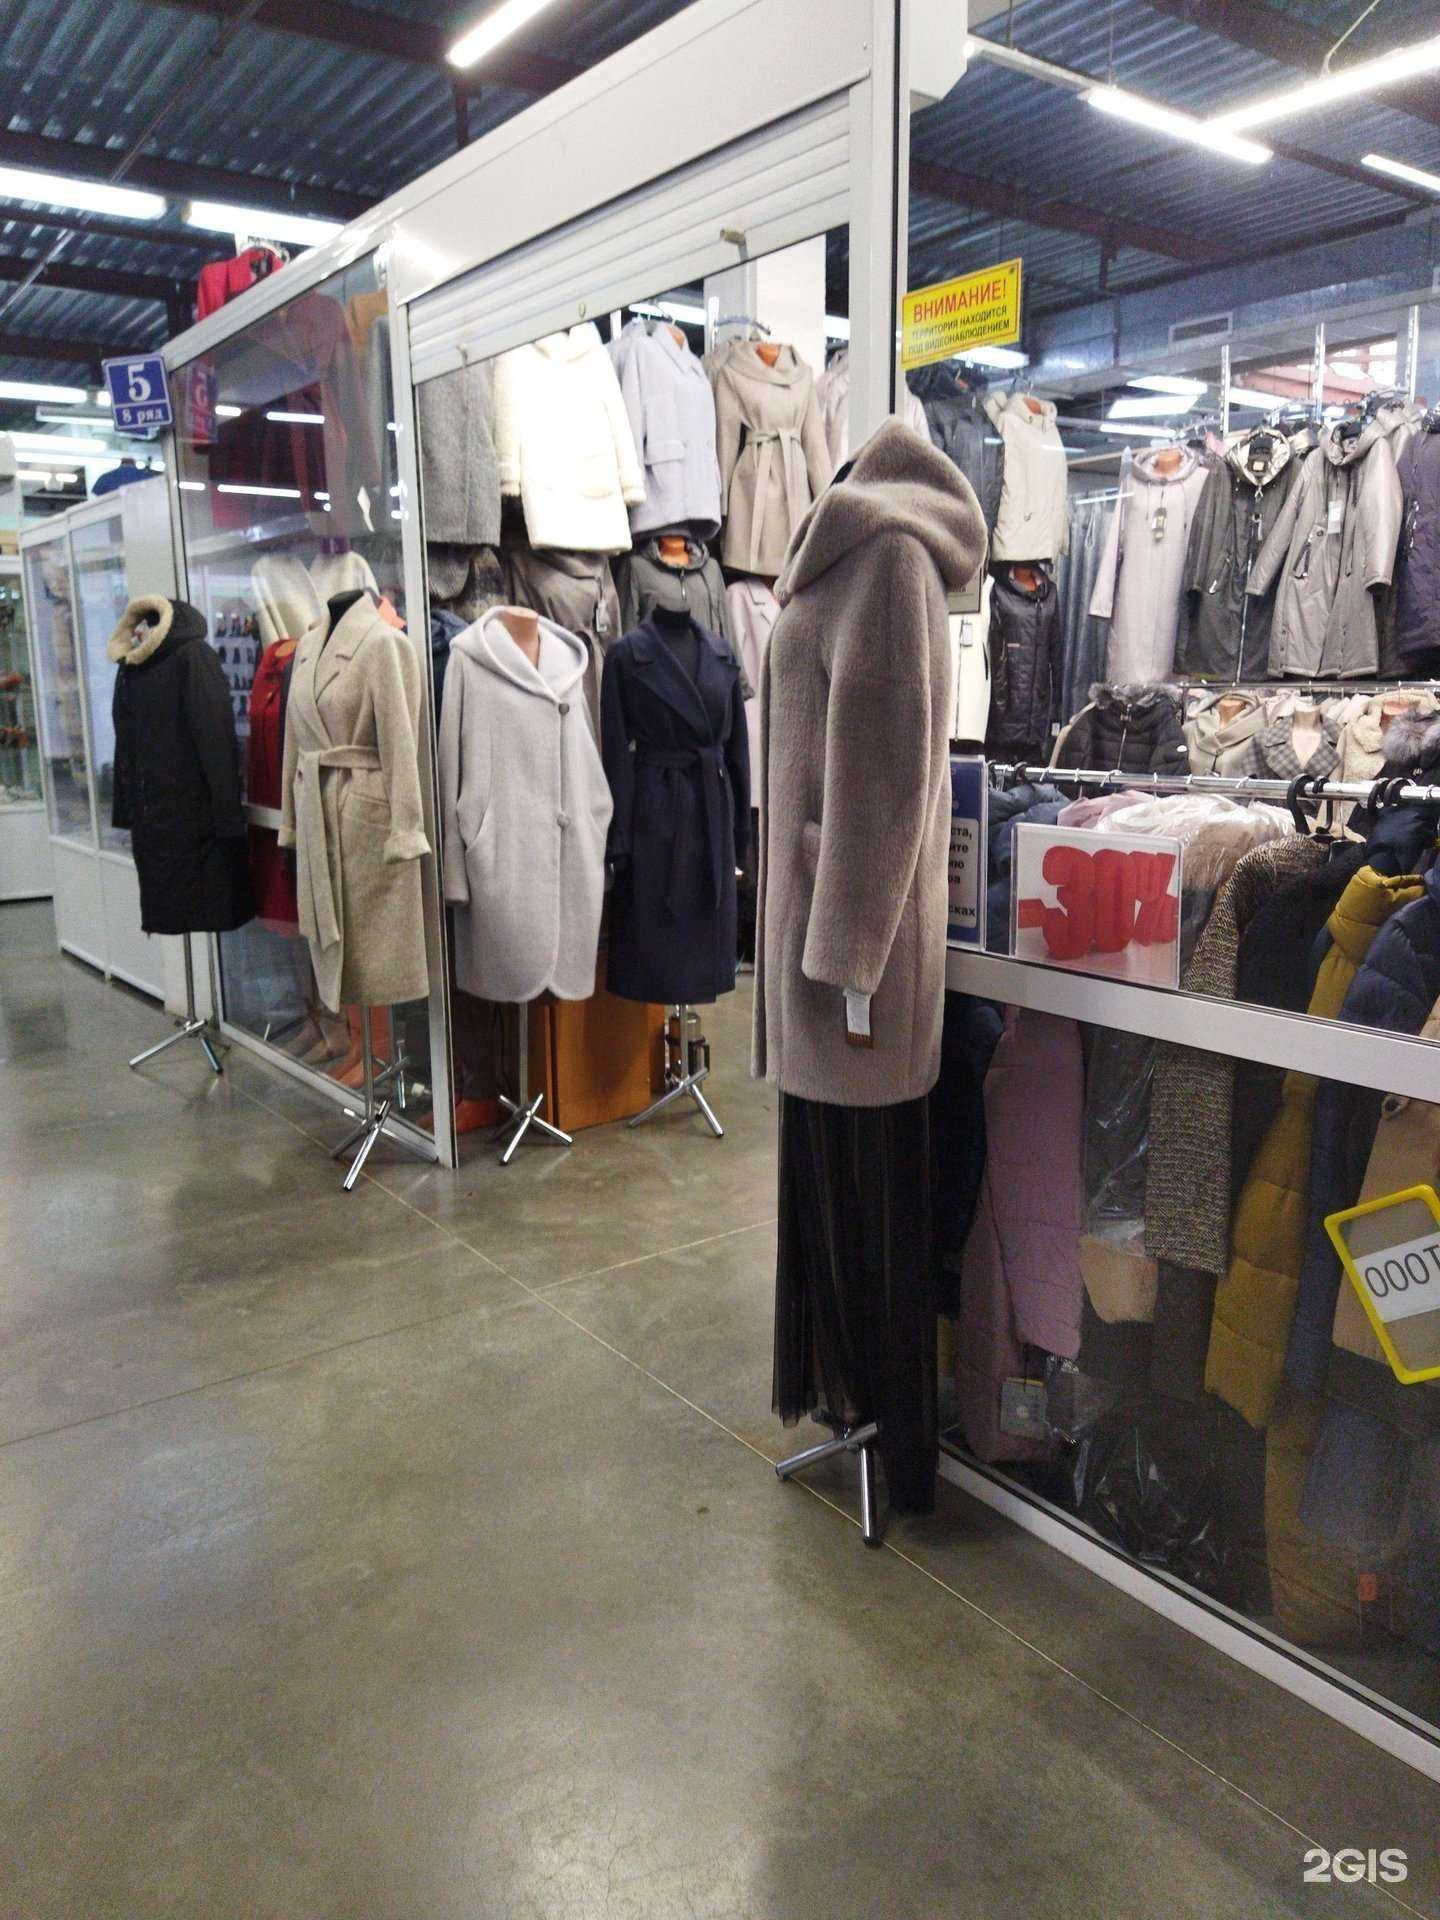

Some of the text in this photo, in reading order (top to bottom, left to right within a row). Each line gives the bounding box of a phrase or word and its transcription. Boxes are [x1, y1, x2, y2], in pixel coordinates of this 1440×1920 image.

[914, 278, 1007, 324] ВНИМАНИЕ!
[912, 304, 1007, 340] ТЕРРИТОРИЯ НАХОДИТСЯ
[925, 319, 1010, 351] ВИДЕОНАБЛЮДЕНИЕМ
[128, 363, 151, 403] 5
[122, 408, 163, 425] 8 ряд
[1018, 846, 1179, 961] -30%
